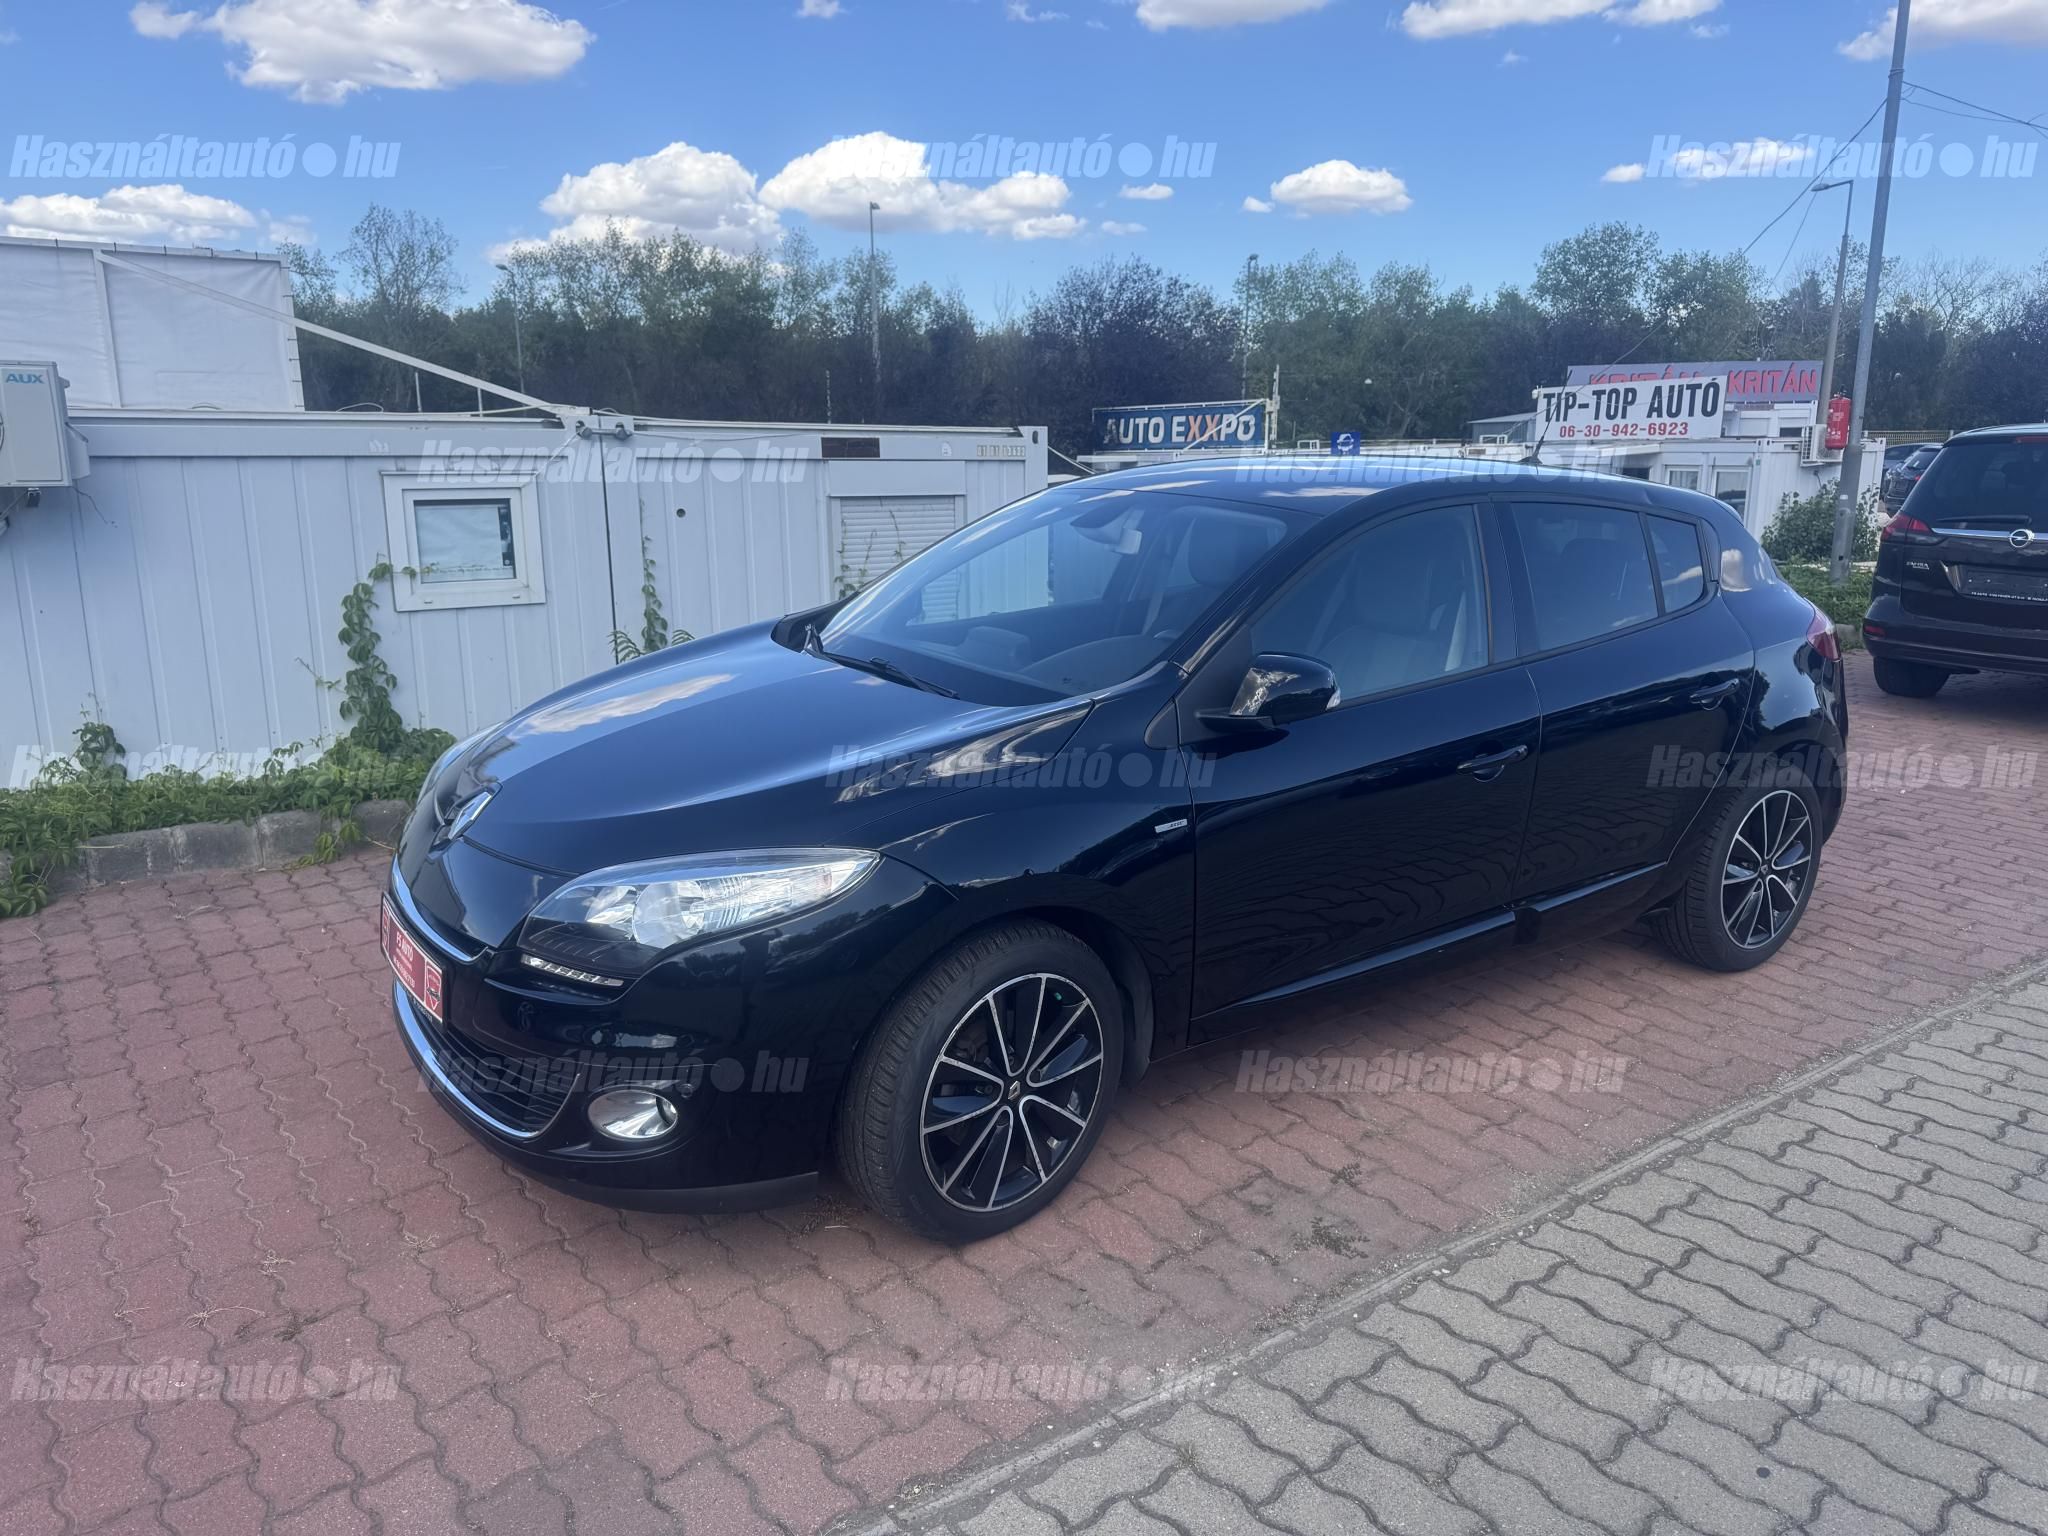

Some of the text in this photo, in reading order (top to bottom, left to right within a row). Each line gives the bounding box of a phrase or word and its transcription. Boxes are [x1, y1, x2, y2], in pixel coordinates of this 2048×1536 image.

[5, 373, 45, 384] AUX
[1727, 362, 1816, 394] KRITÁN
[1543, 377, 1720, 423] TIP-TOP AUTÓ
[1103, 413, 1255, 444] AUTO EXXPO
[1559, 422, 1689, 438] 06-30-942-6923
